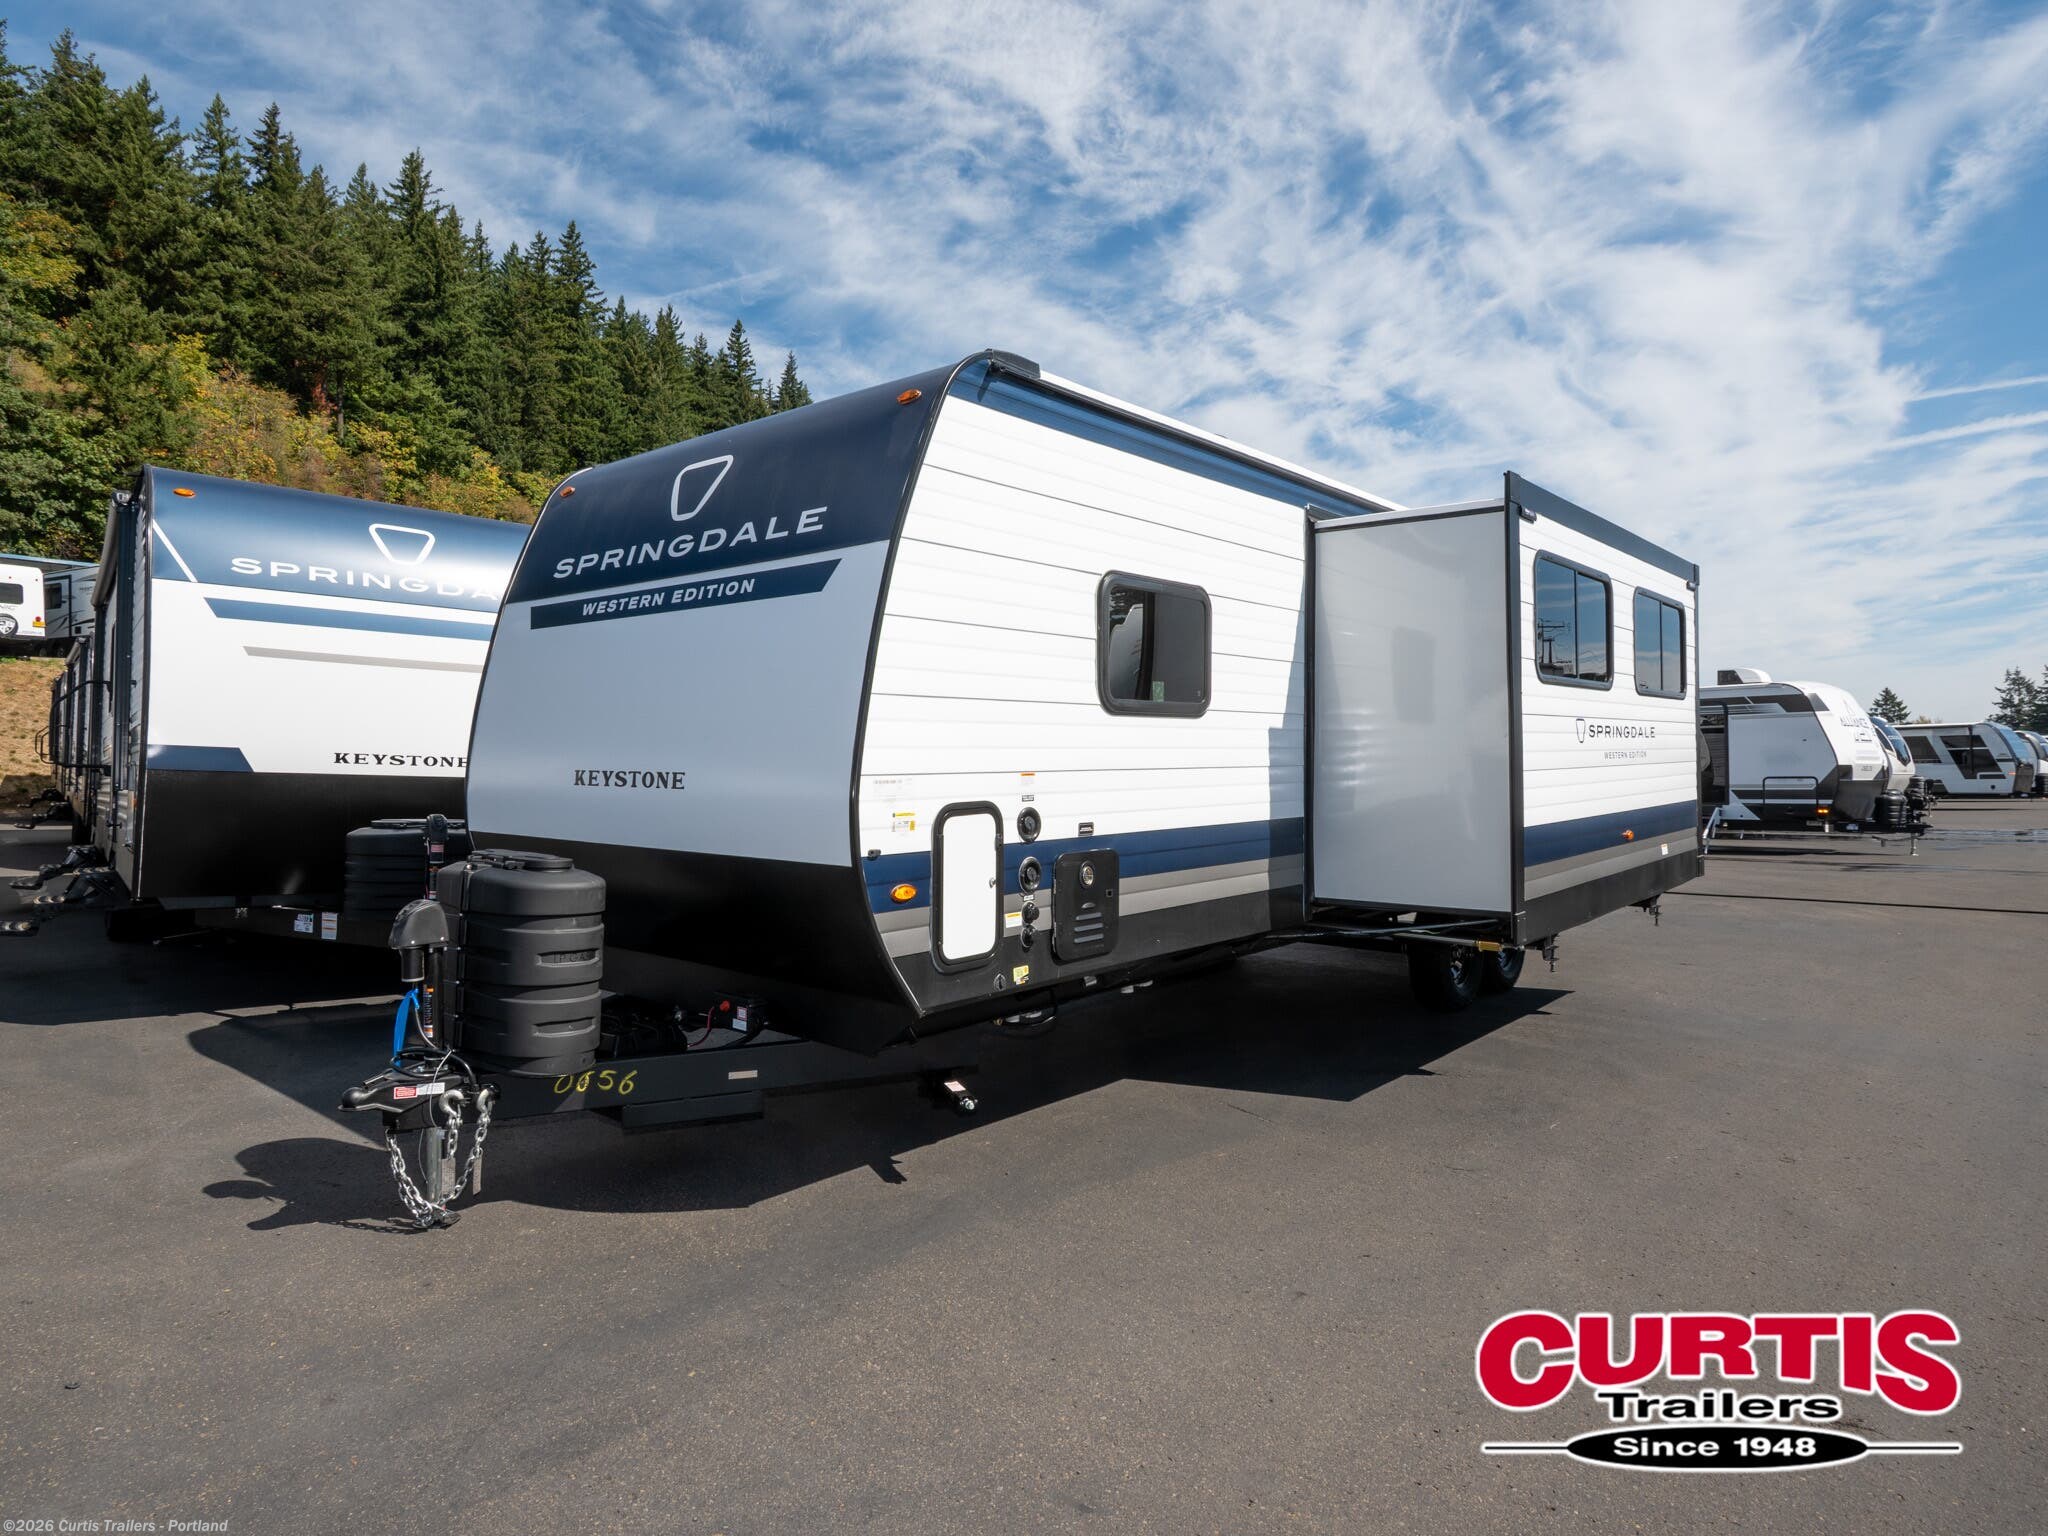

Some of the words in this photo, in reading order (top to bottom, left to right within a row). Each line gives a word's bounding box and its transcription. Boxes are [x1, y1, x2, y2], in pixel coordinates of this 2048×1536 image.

[553, 506, 828, 579] SPRINGDALE
[582, 592, 665, 616] WESTERN
[671, 578, 756, 604] EDITION
[1588, 724, 1656, 739] SPRINGDALE
[334, 752, 468, 768] KEYSTONE
[574, 769, 686, 790] KEYSTONE
